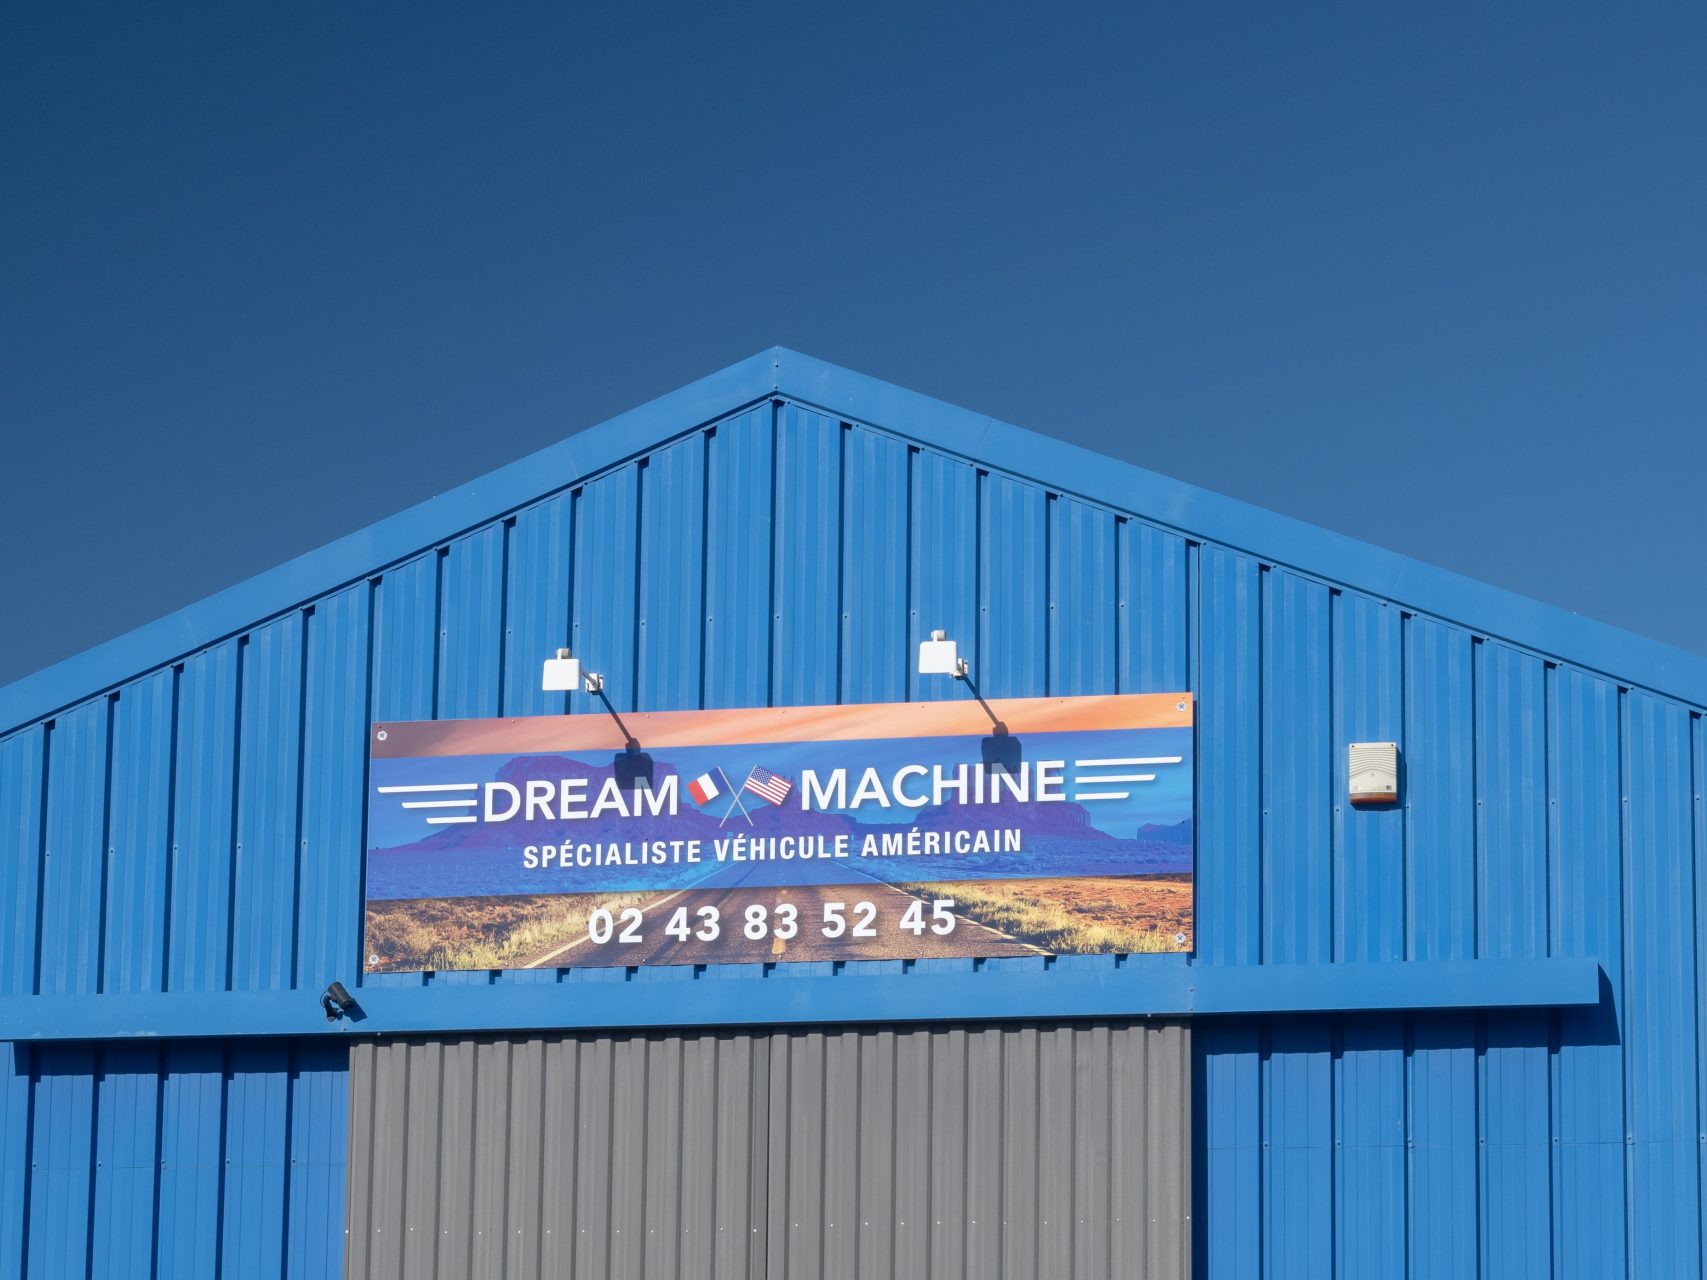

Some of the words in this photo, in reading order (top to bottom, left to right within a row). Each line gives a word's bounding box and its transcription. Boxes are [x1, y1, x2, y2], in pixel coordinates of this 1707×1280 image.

[484, 774, 678, 823] DREAM
[801, 759, 1066, 811] MACHINE
[523, 839, 702, 869] SPÉCIALISTE
[714, 833, 848, 862] VÉHICULE
[861, 827, 1022, 857] AMÉRICAIN
[588, 907, 643, 944] 02
[665, 905, 720, 942] 43
[744, 903, 798, 940] 83
[821, 901, 877, 938] 52
[900, 899, 956, 936] 45
